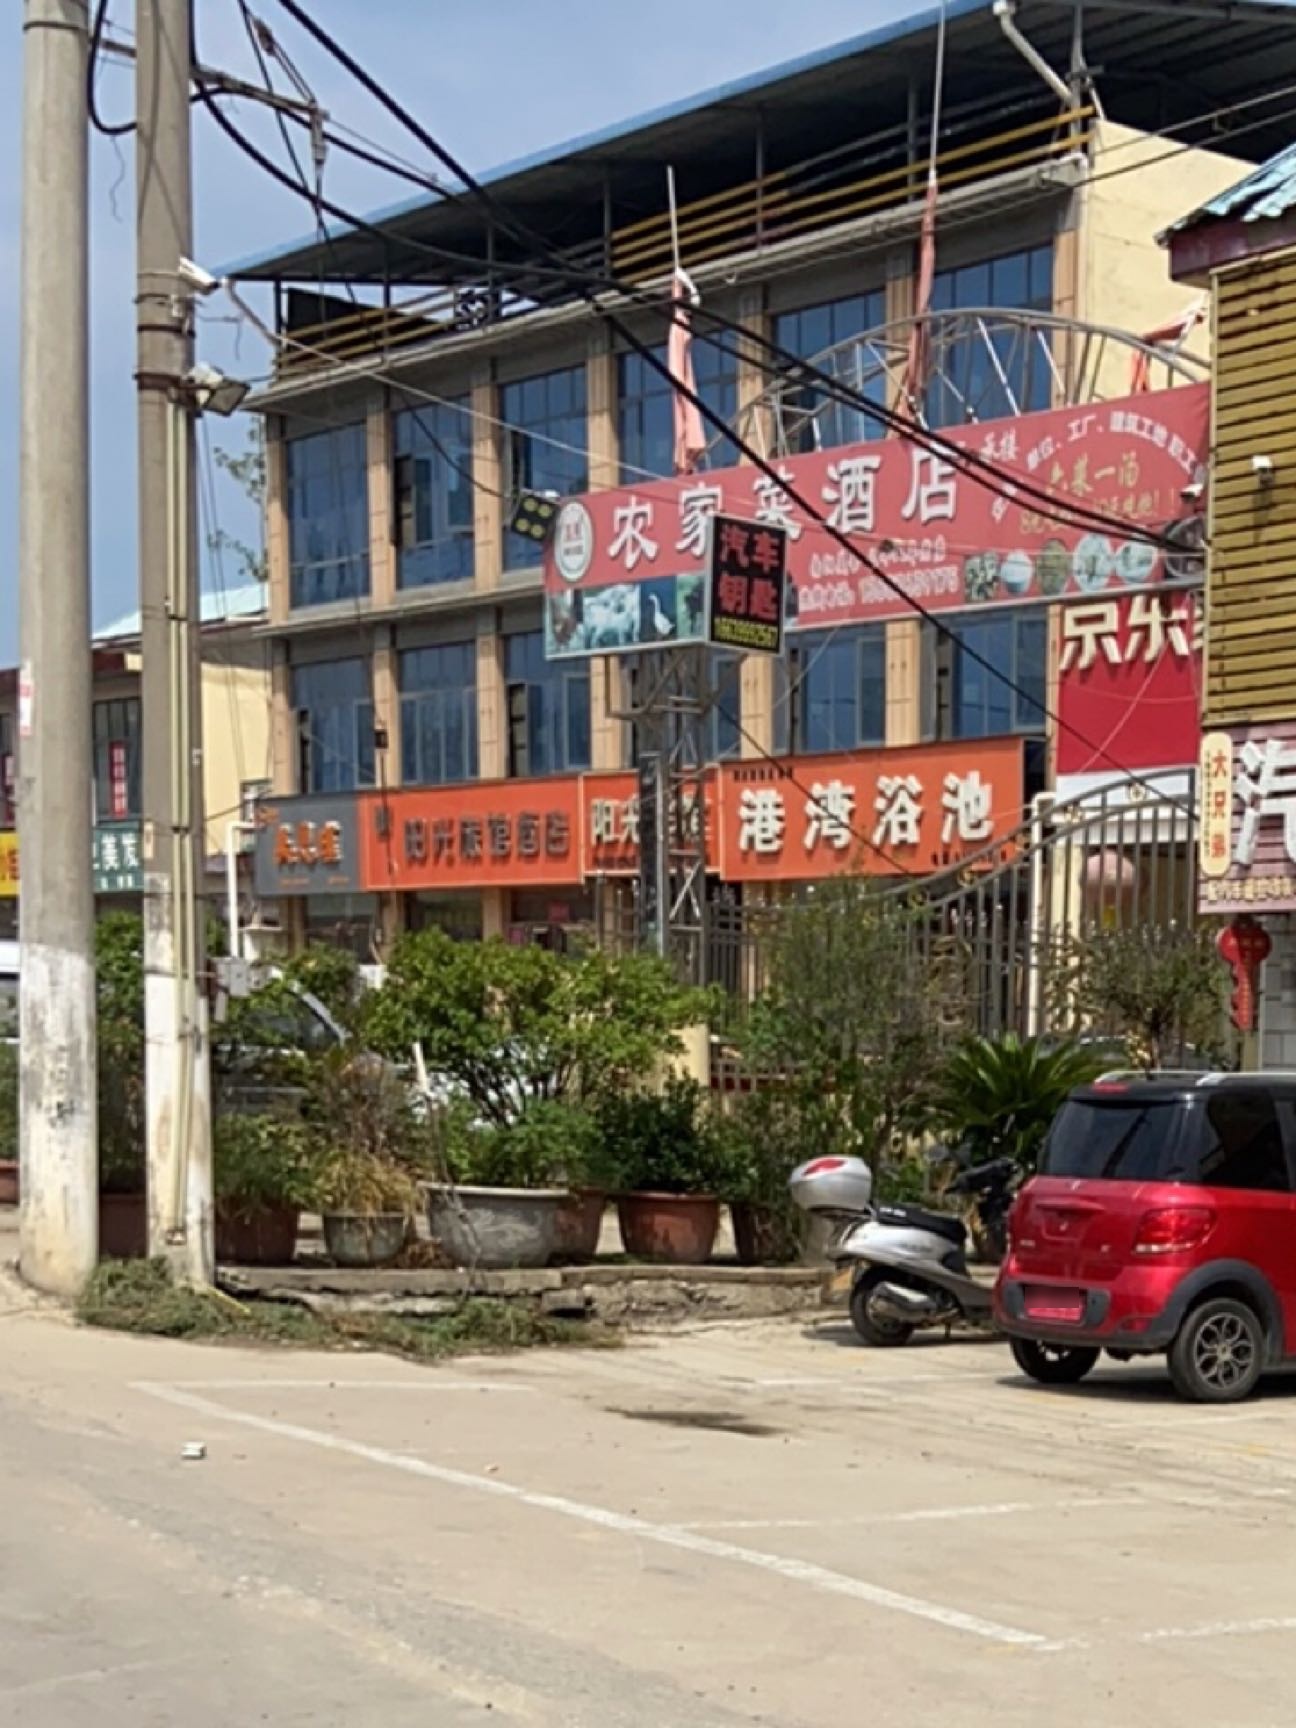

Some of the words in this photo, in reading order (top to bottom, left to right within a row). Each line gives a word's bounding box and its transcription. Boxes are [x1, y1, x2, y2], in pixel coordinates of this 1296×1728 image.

[608, 446, 957, 569] 农家菜酒店
[720, 525, 780, 573] 汽车
[1060, 594, 1203, 670] 京东
[739, 771, 994, 852] 港湾浴池
